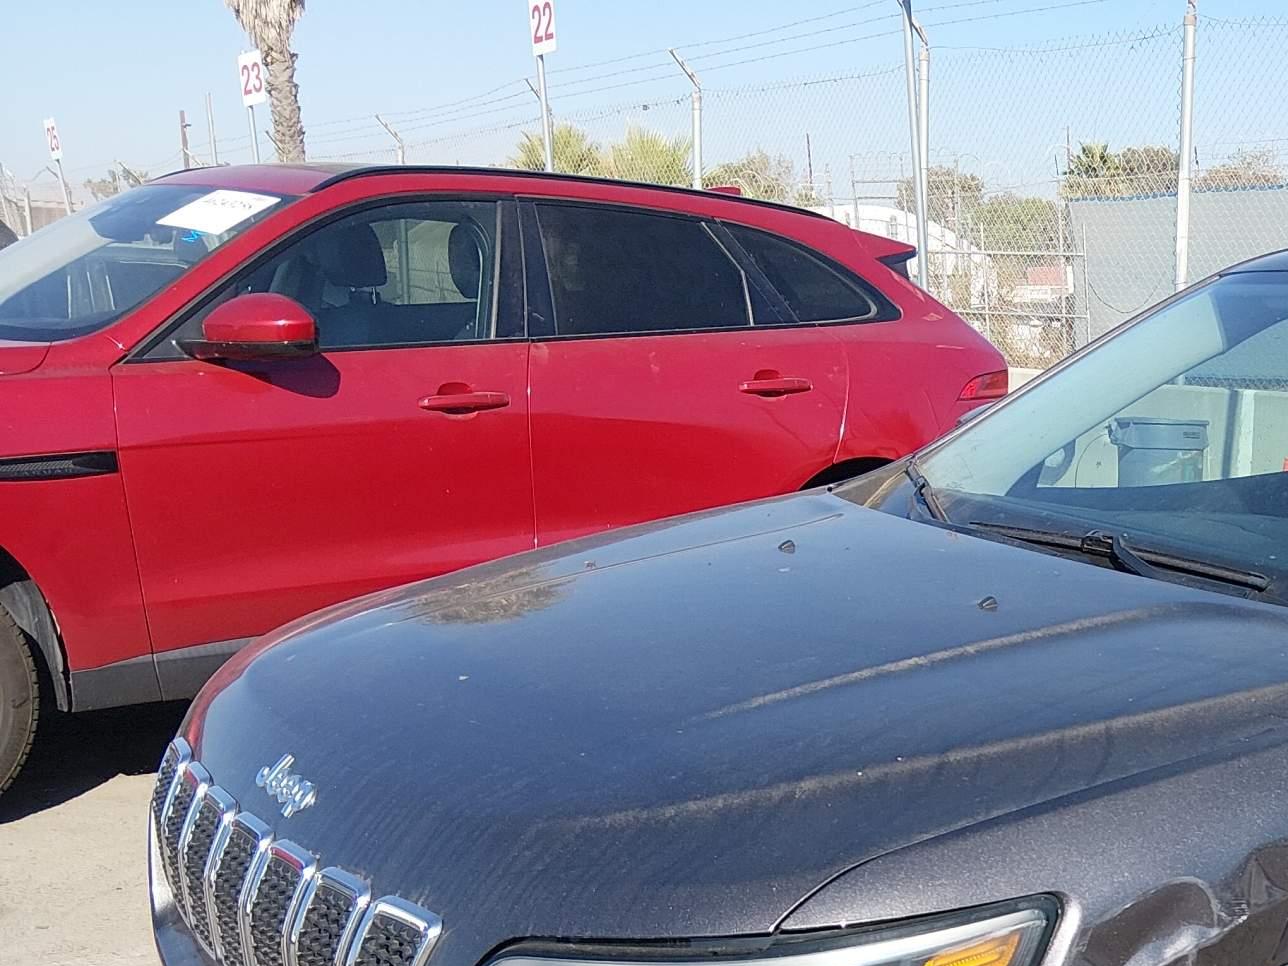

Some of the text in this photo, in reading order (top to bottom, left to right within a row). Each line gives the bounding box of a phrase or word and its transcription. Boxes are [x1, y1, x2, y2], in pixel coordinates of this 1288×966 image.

[532, 1, 554, 44] 22
[241, 62, 262, 96] 23
[46, 126, 60, 152] 25
[256, 752, 317, 818] Jeep
